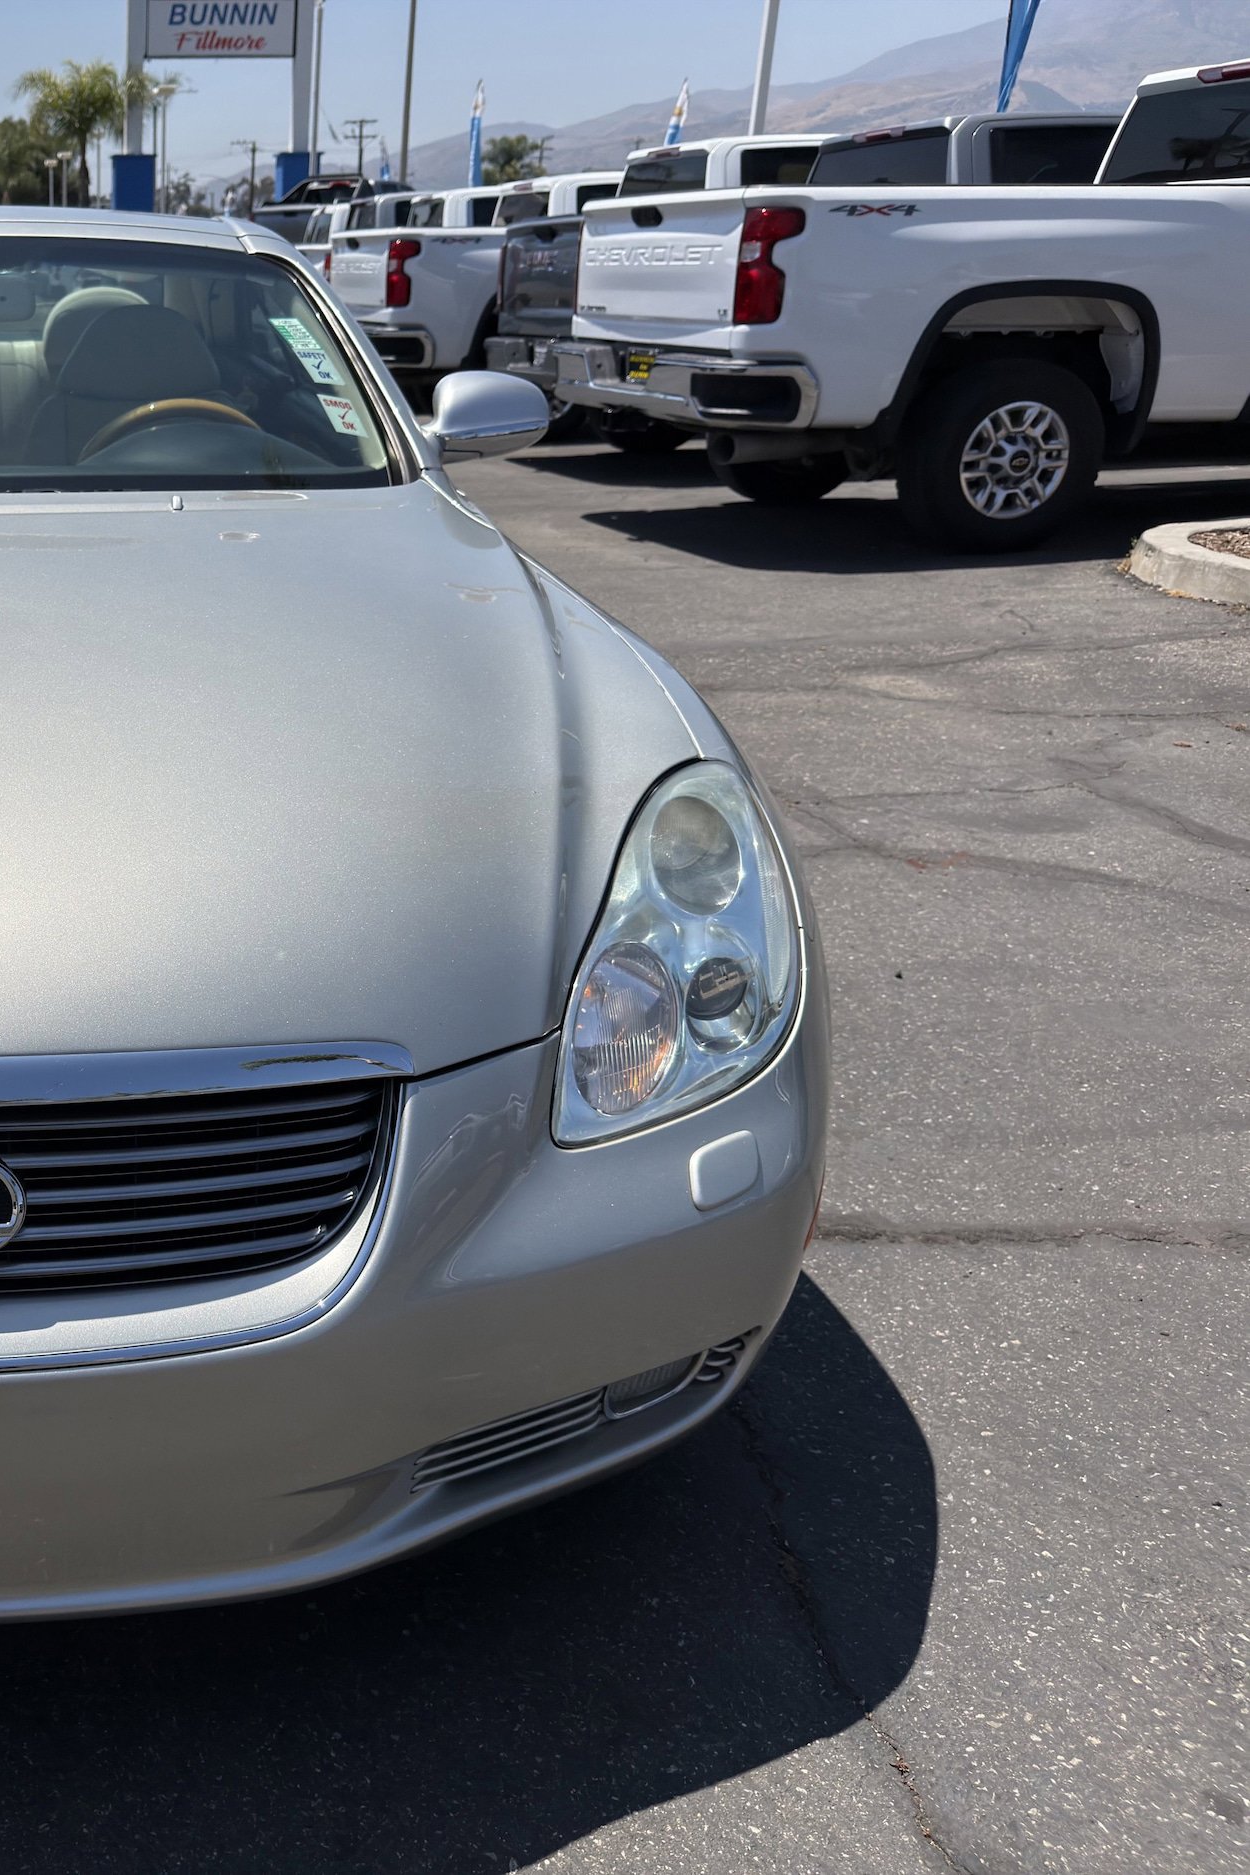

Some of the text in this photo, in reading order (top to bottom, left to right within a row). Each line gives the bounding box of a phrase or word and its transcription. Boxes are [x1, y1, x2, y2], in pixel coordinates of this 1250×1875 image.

[168, 3, 278, 26] BUNNIN
[173, 30, 266, 51] Fillmore
[585, 244, 724, 267] CHEVROLET
[297, 351, 327, 360] SAFETY
[317, 371, 333, 380] OK
[323, 399, 353, 410] SMOG
[342, 421, 357, 432] OK
